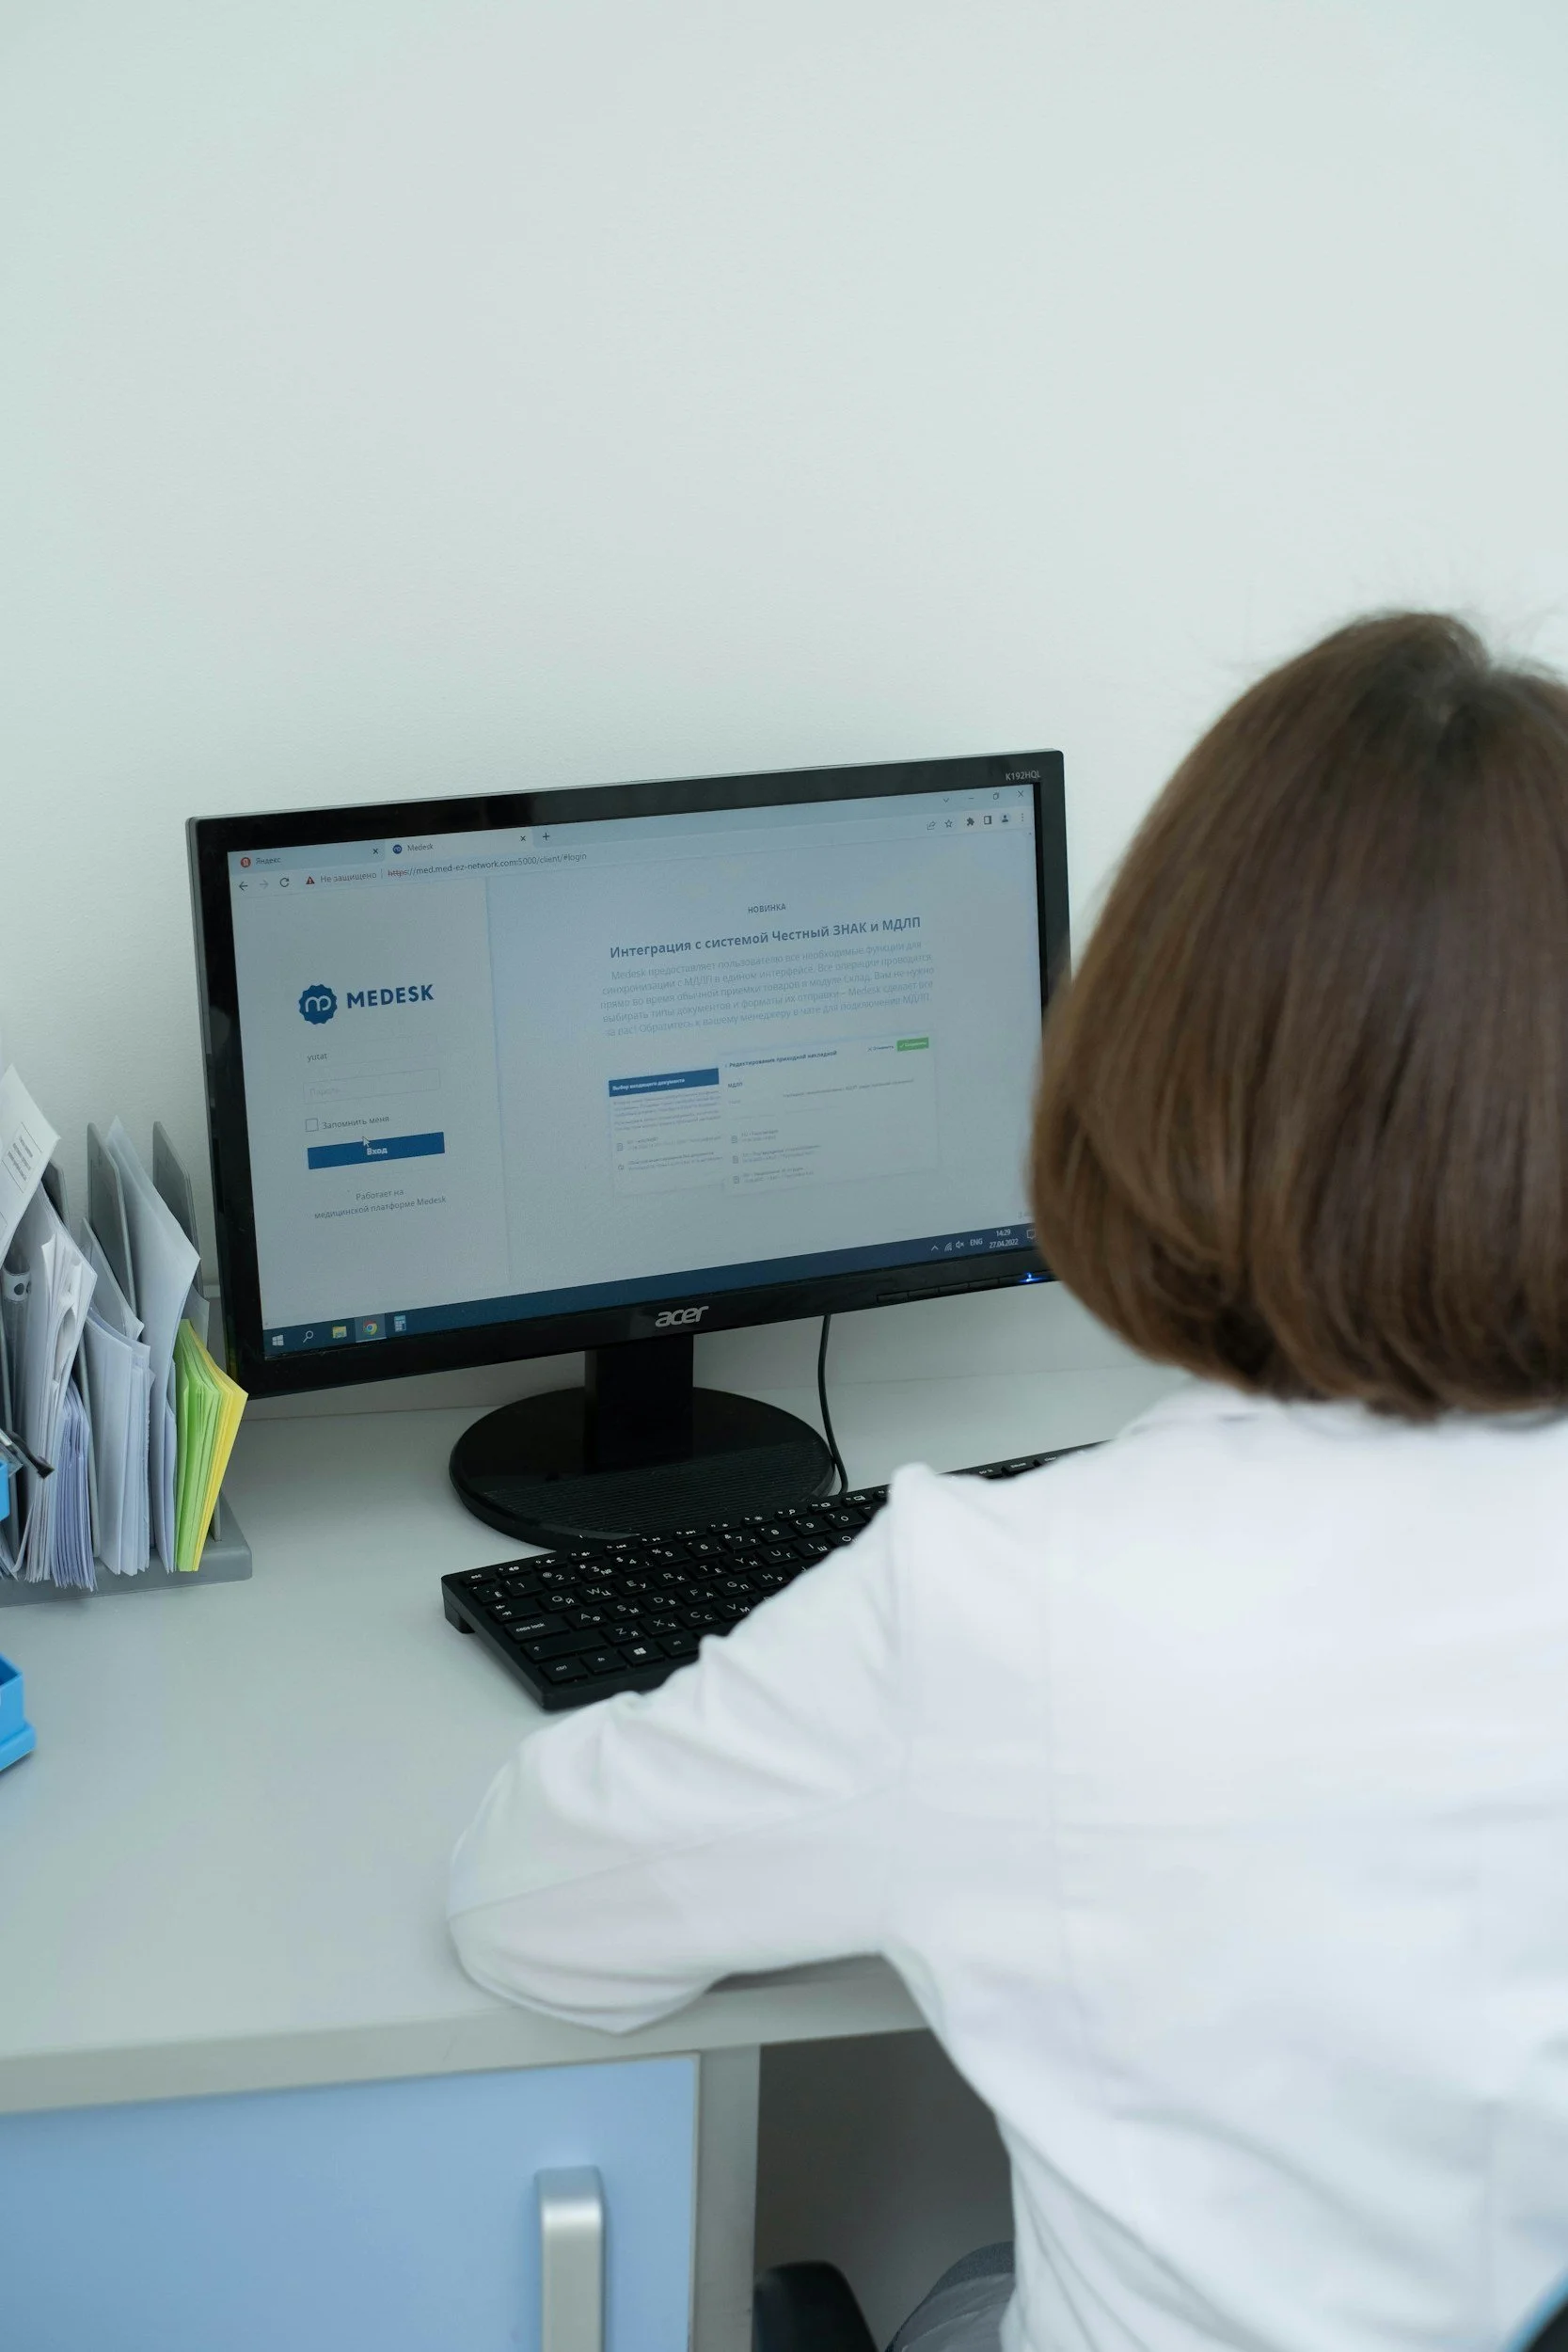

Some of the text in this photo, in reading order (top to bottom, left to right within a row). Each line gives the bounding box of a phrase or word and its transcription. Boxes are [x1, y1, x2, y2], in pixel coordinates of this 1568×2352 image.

[1006, 771, 1040, 781] K192HQL
[407, 843, 434, 851] Medesk
[334, 871, 376, 882] защищено
[748, 902, 786, 914] НОВИНКА
[610, 916, 921, 958] Интеграция с системой Честный ЗНАК и МДЛП
[347, 984, 434, 1009] MEDESK
[322, 1119, 367, 1130] Запомнить
[367, 1147, 388, 1155] Вход
[356, 1191, 392, 1200] Работает
[314, 1196, 446, 1219] медицинской платформе Medesk
[970, 1238, 983, 1247] ENG
[656, 1306, 709, 1327] acer
